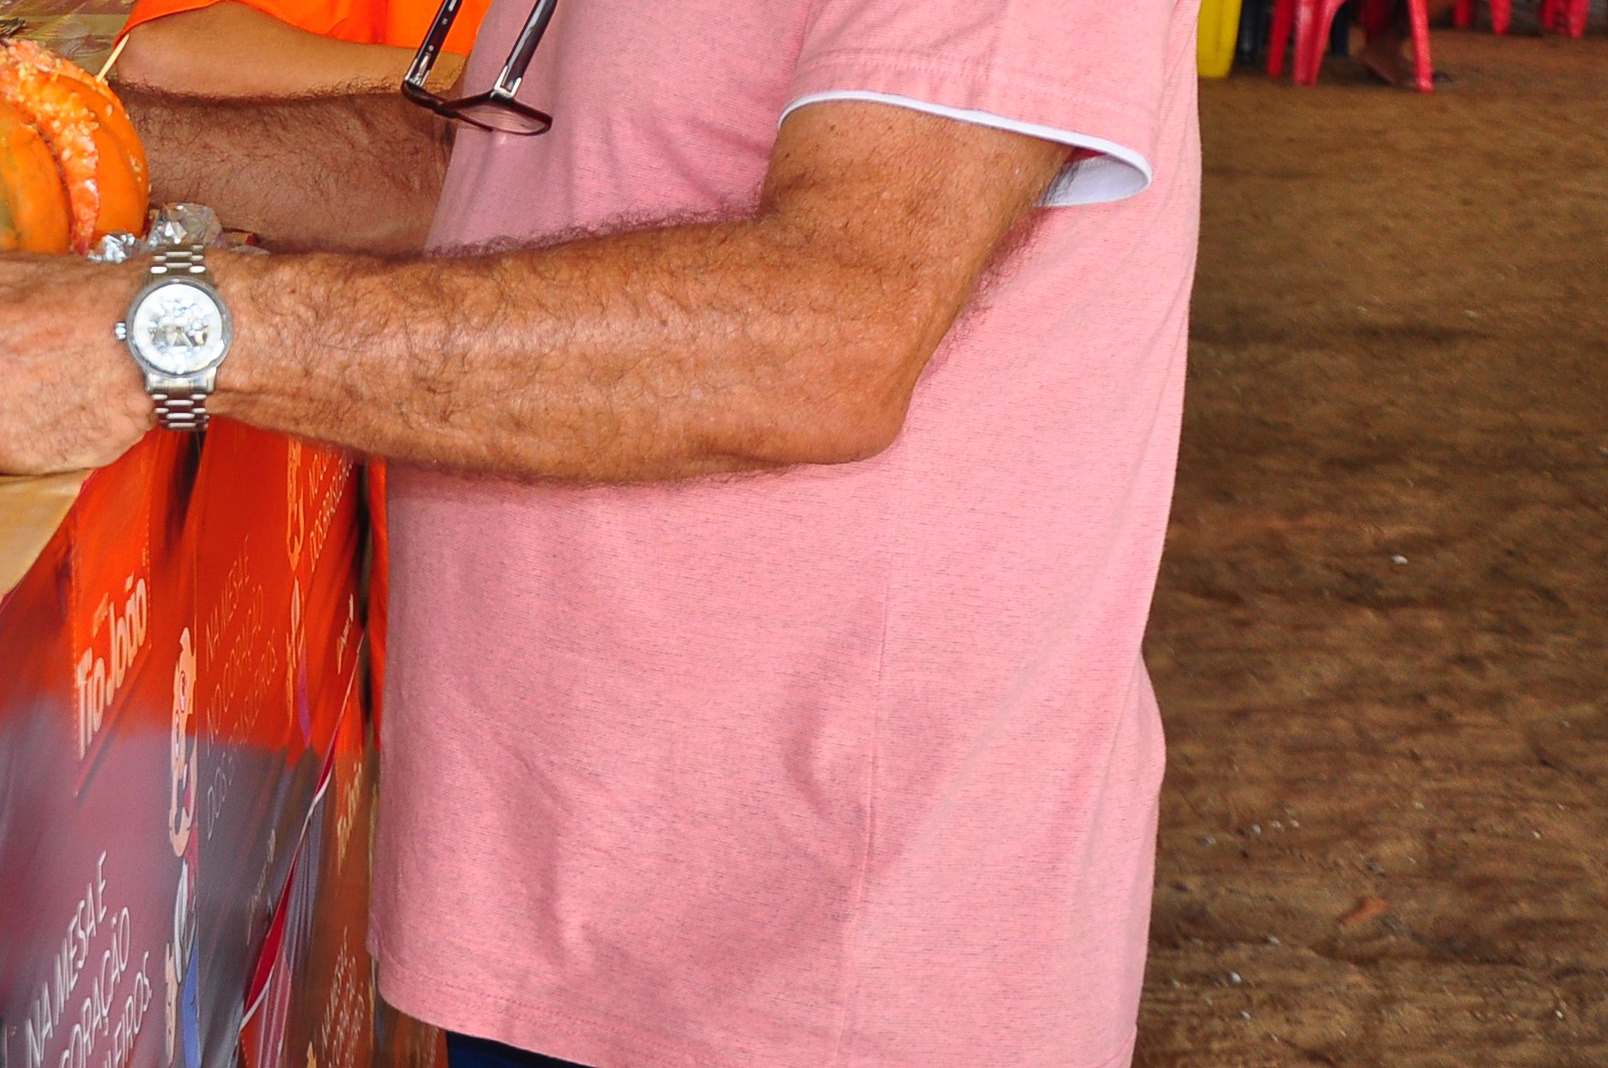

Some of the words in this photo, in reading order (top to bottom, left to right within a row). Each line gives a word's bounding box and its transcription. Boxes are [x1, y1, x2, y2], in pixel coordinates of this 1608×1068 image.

[76, 646, 106, 761] Tio
[106, 572, 148, 706] João
[55, 882, 97, 1026] MESA
[96, 850, 108, 923] E
